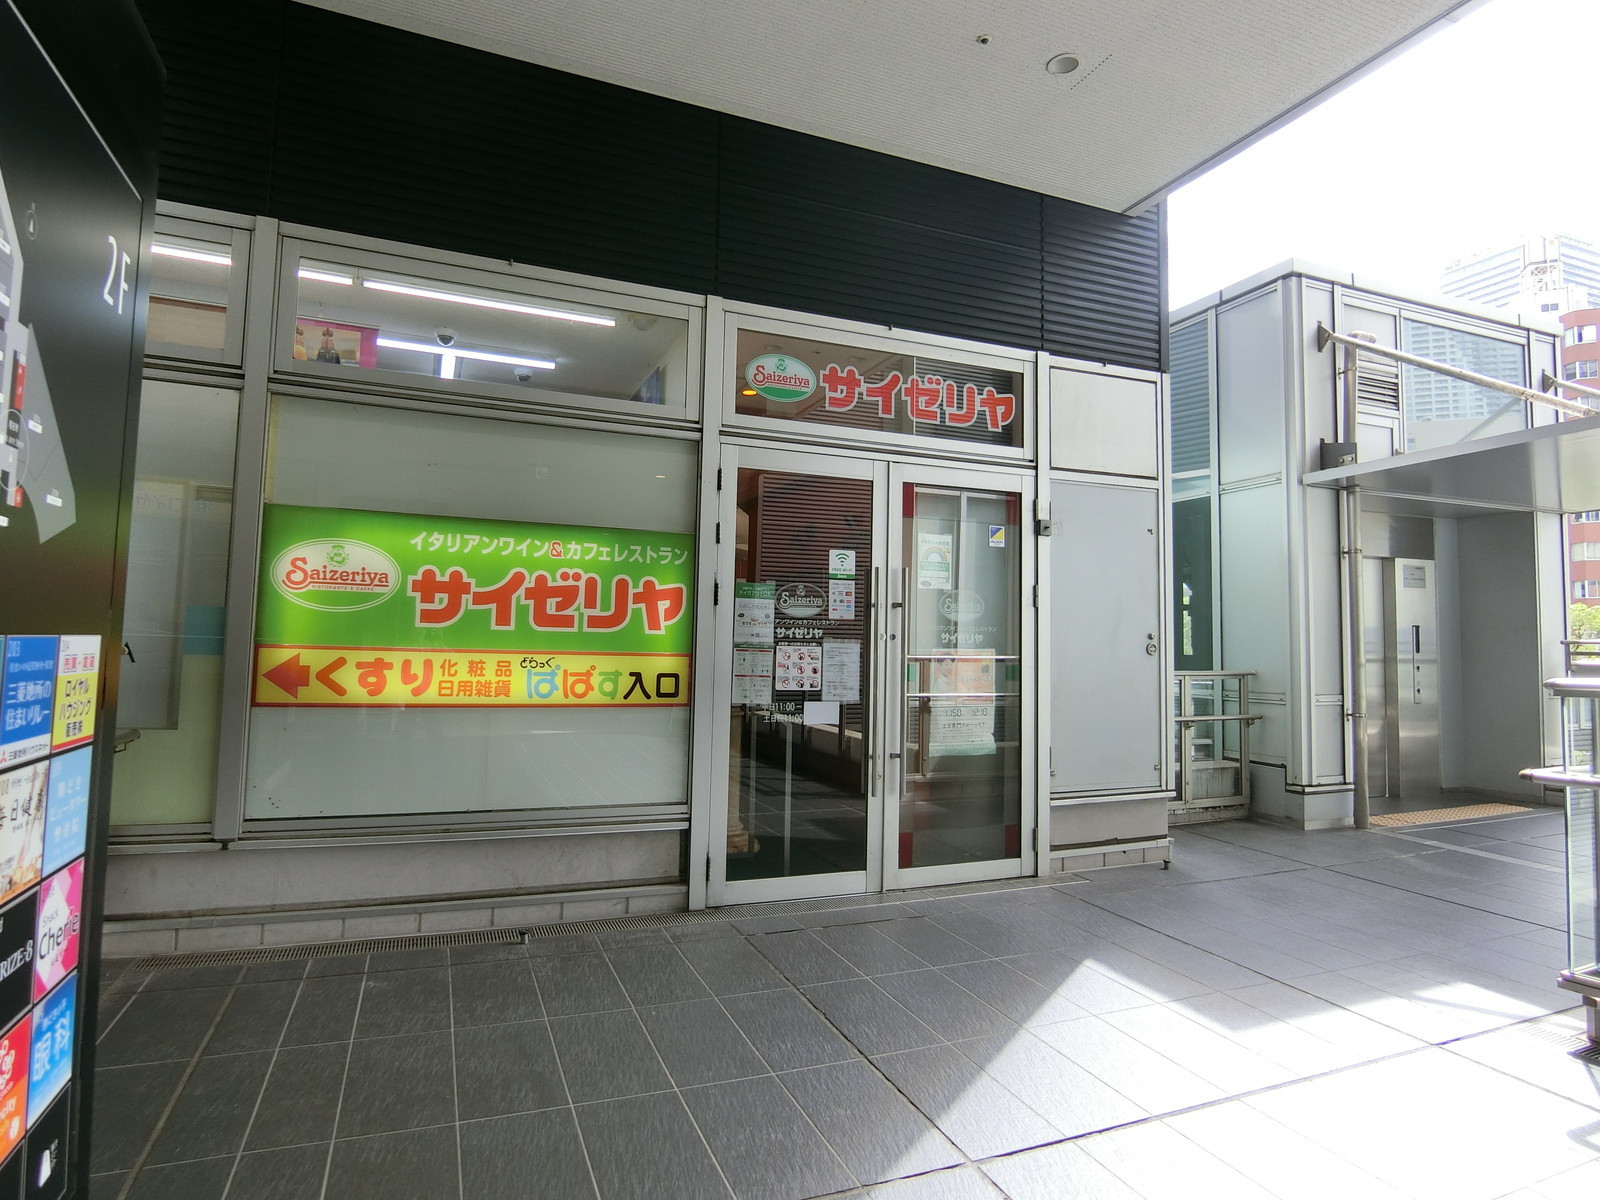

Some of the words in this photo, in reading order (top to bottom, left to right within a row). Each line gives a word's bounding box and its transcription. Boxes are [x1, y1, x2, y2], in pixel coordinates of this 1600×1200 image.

[103, 235, 131, 315] 2F
[752, 364, 811, 389] Saizeriya
[819, 363, 1016, 432] サイゼリヤ
[409, 530, 689, 566] イタリアンワイン&カフェレストラン
[281, 556, 390, 591] Saizeriya
[407, 565, 688, 634] サイゼリヤ
[779, 591, 823, 609] Saizeriya
[775, 626, 823, 639] サイゼリヤ
[940, 633, 984, 644] サイゼリヤ
[7, 680, 52, 704] 三菱地所の
[315, 656, 435, 698] くすり
[439, 659, 513, 679] 化粧品
[519, 656, 557, 669] どらっぐ
[437, 679, 512, 699] 日用雑貨
[6, 705, 50, 731] 住まいリレー
[59, 697, 92, 721] ハウジング
[0, 939, 33, 981] RIZE-8
[33, 1010, 71, 1082] 眼科
